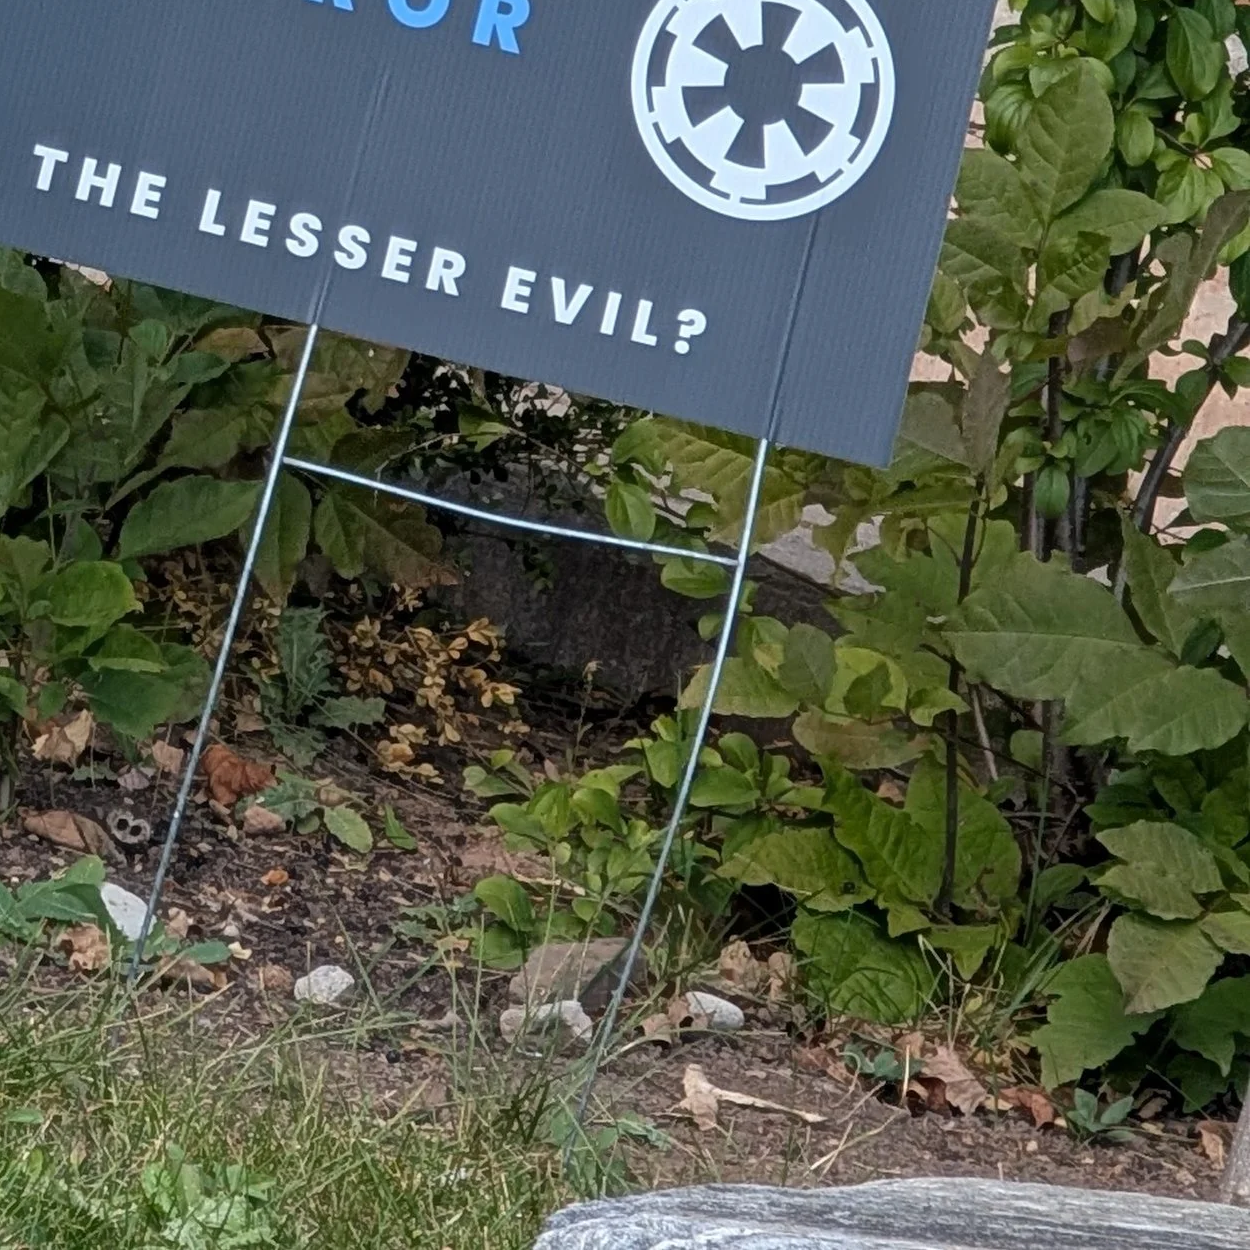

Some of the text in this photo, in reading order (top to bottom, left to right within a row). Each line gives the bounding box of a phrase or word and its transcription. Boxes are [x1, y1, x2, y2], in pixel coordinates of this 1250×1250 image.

[32, 143, 168, 220] THE
[198, 187, 467, 297] LESSER
[500, 265, 708, 355] EVIL?
